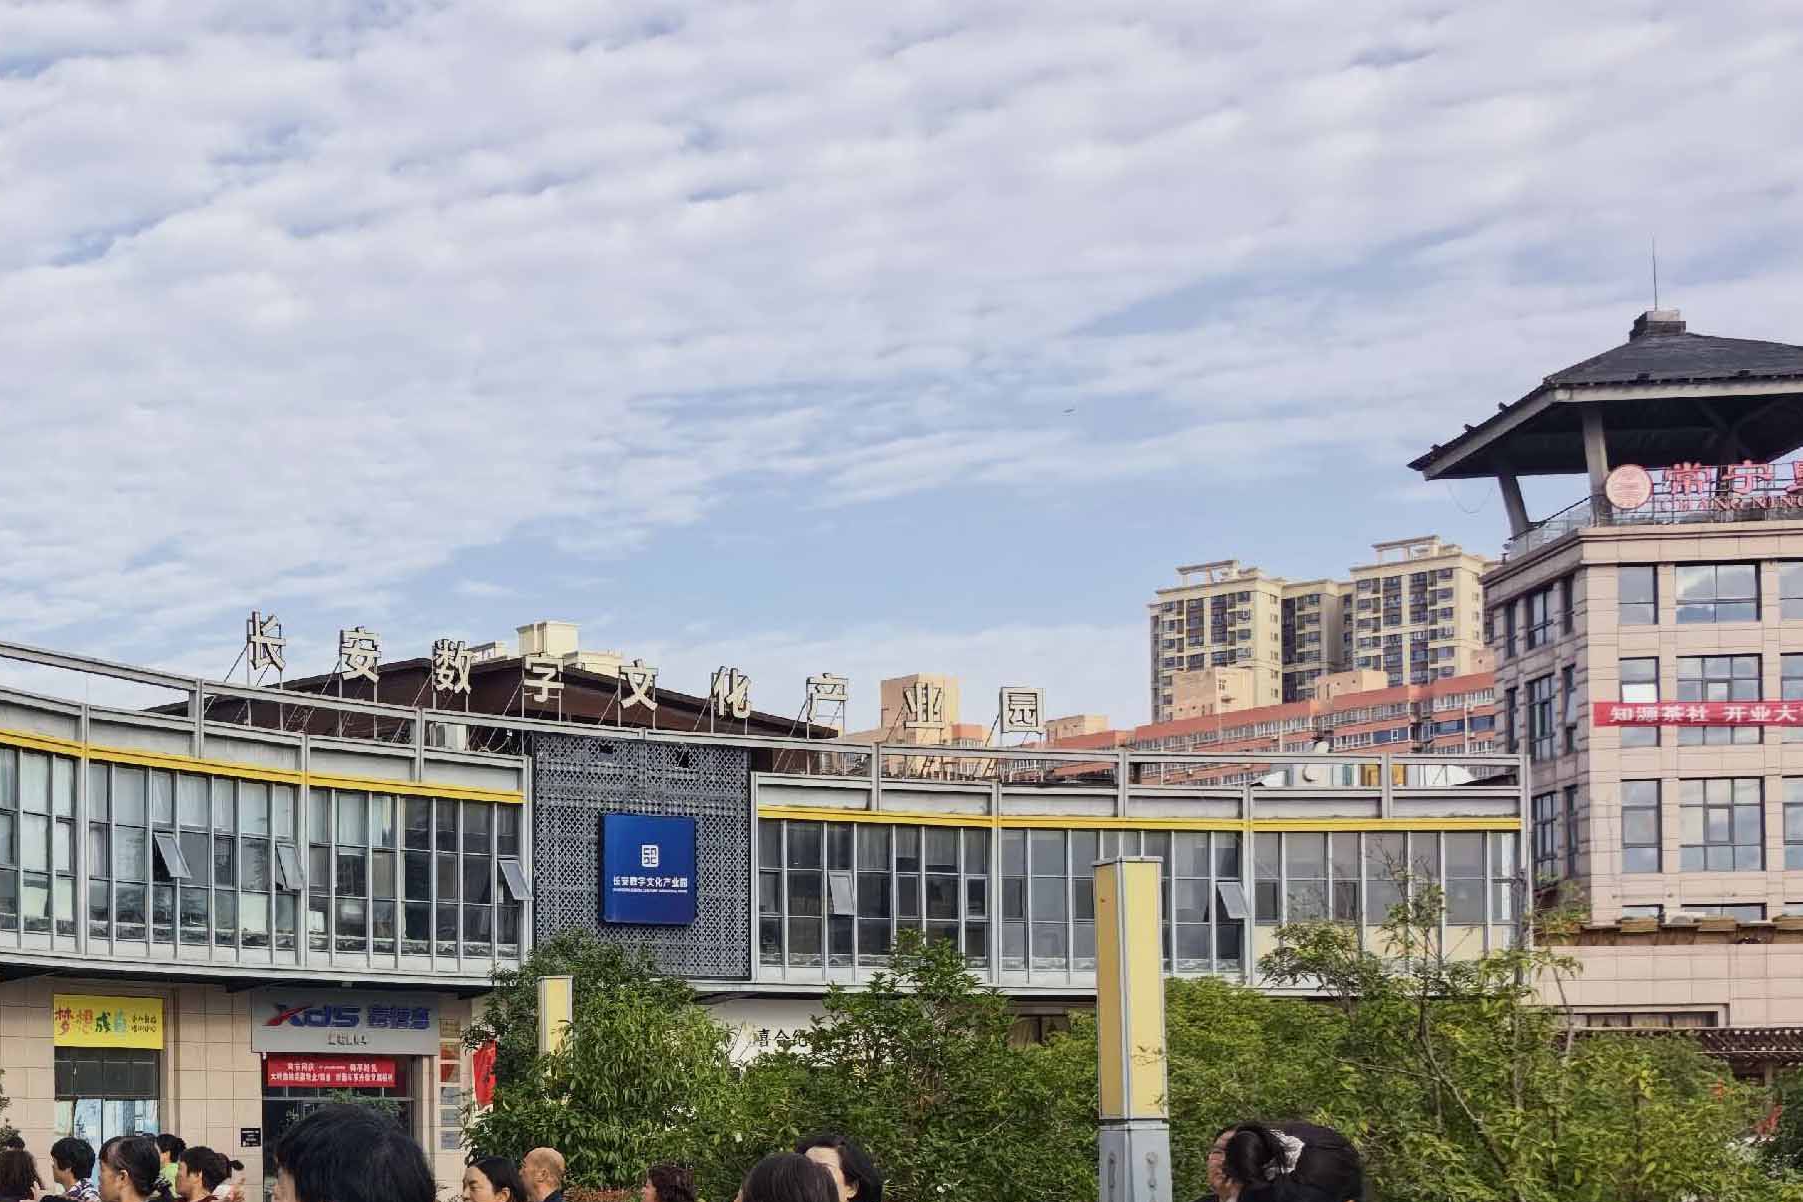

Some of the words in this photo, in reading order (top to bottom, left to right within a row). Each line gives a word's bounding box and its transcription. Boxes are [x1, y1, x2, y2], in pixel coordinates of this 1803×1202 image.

[246, 610, 1047, 733] 长安数字文化产业园
[1723, 704, 1803, 722] 开业大
